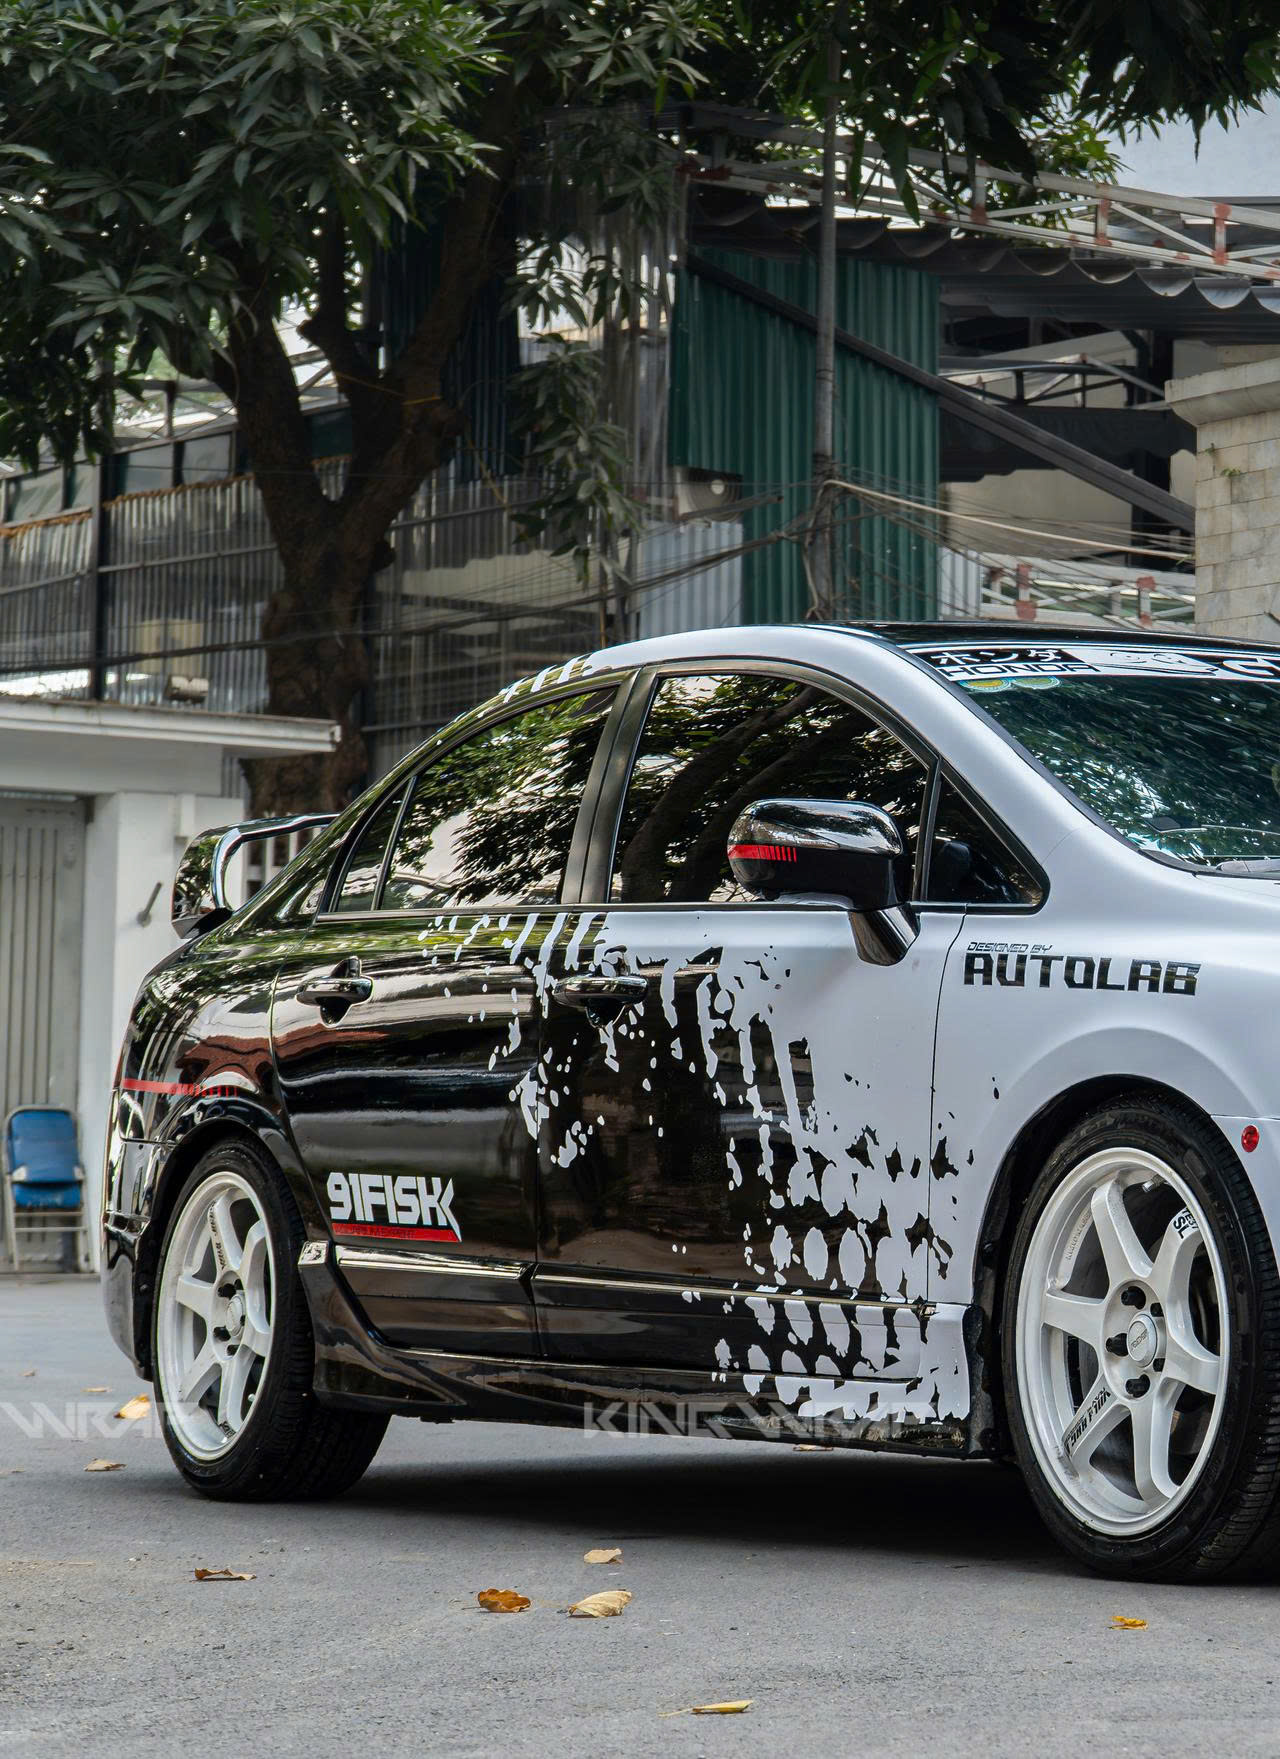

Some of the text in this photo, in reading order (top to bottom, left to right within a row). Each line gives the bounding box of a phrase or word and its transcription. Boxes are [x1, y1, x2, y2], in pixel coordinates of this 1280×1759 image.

[938, 663, 1102, 678] HONDA
[967, 941, 1053, 953] DESIGNED BY
[963, 952, 1201, 996] AUTOLAB
[1173, 1216, 1190, 1240] SL
